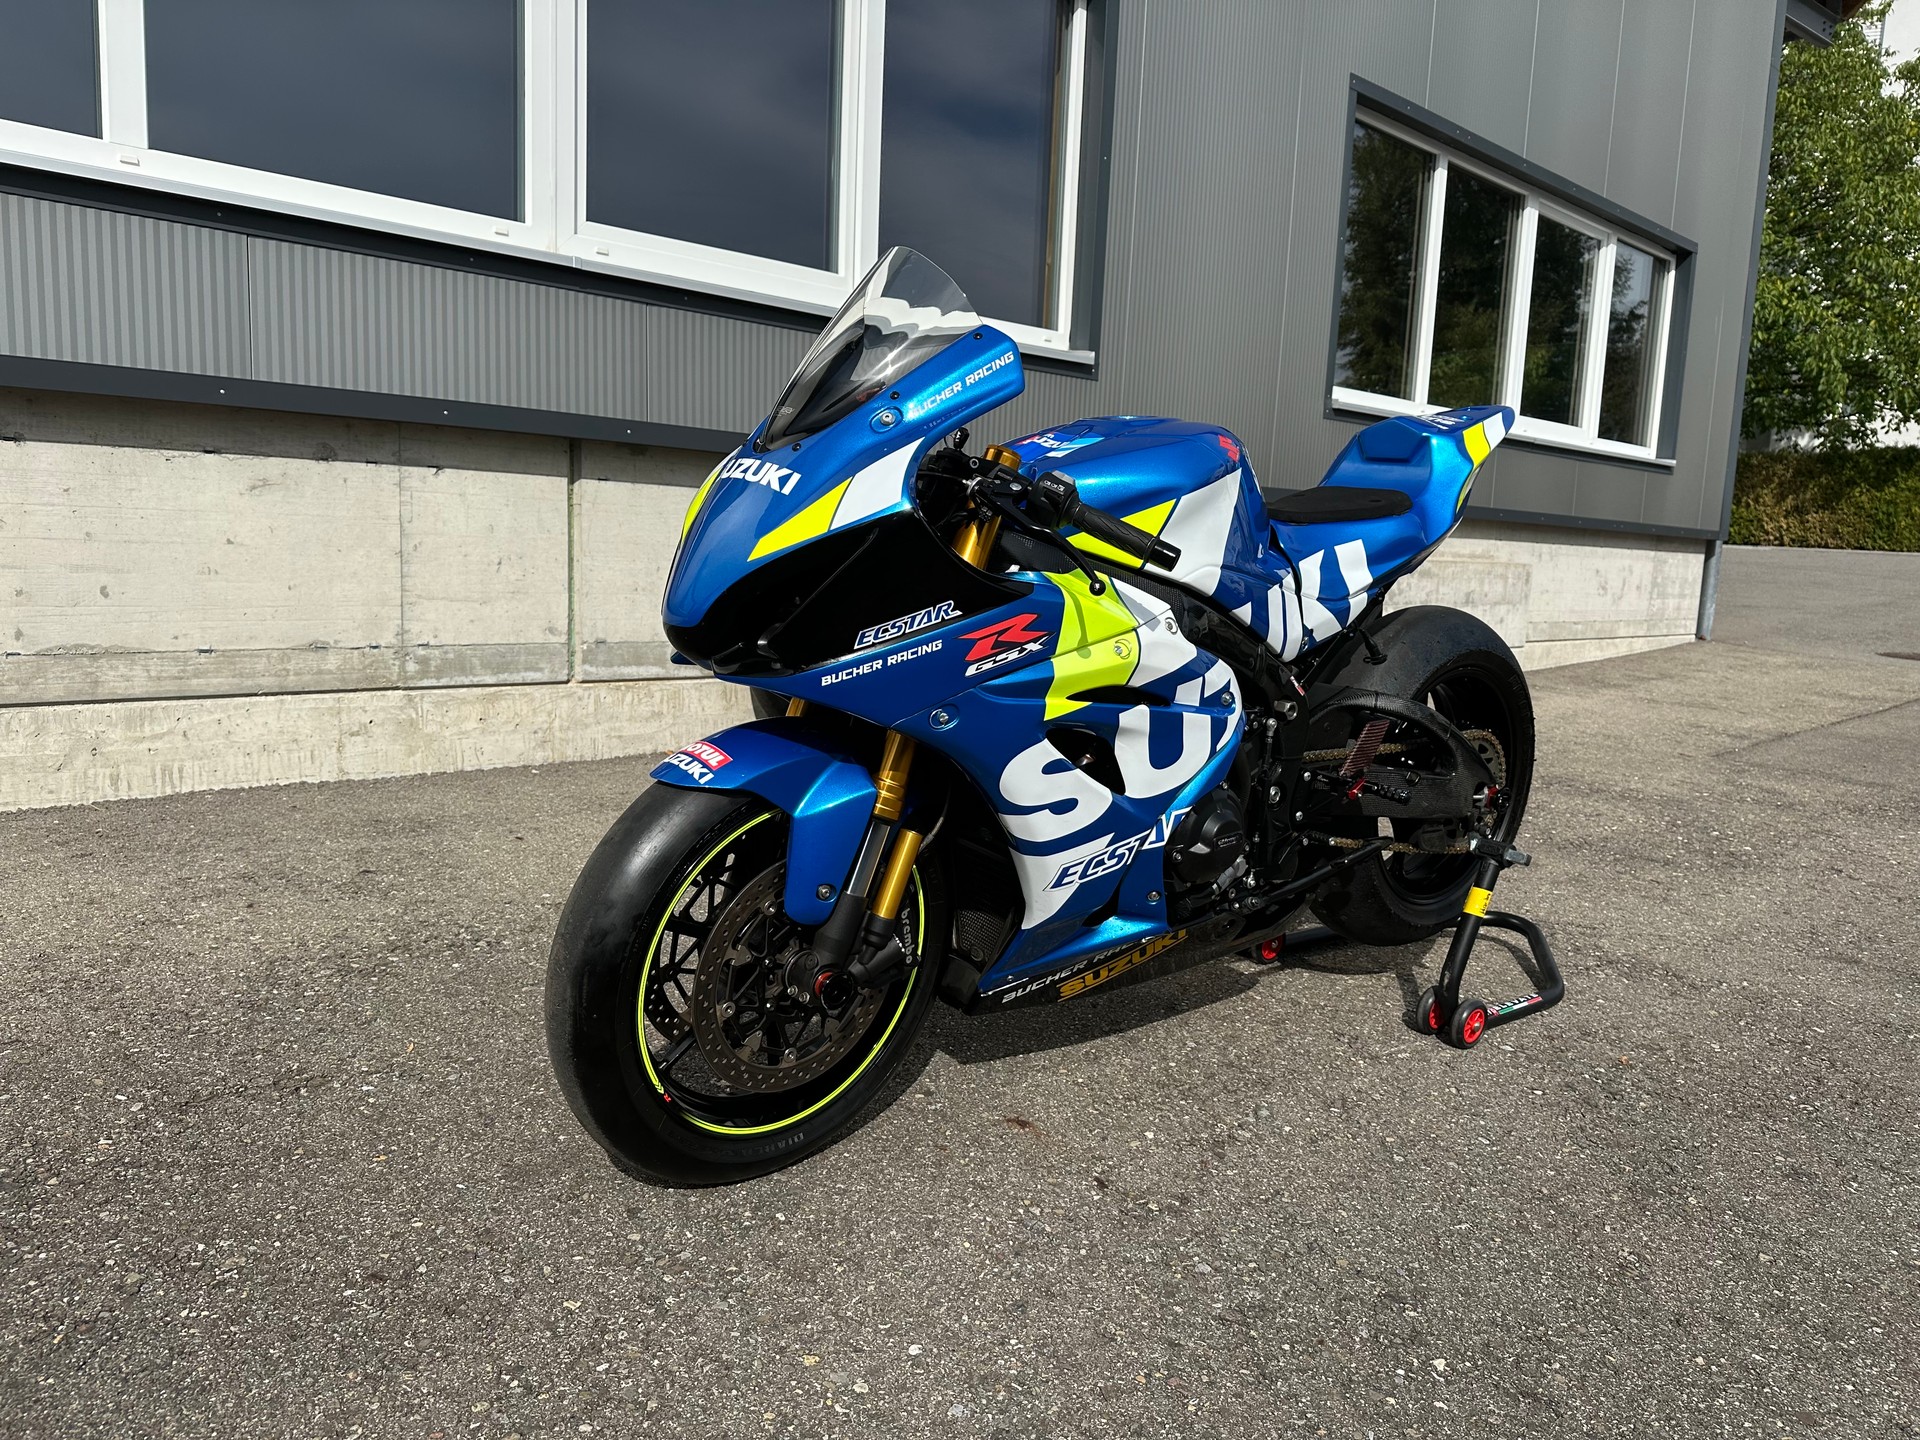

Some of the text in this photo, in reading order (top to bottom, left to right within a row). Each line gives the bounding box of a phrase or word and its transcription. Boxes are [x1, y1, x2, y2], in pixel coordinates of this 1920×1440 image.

[965, 351, 1015, 386] RACING
[720, 458, 802, 496] UZUKI
[854, 600, 963, 650] ECSTAR
[821, 639, 943, 687] BUCHER RACING
[964, 633, 1054, 677] GSX
[685, 742, 725, 767] OTUL
[901, 907, 915, 964] brembo
[1002, 960, 1089, 1003] BUCHER
[1060, 928, 1187, 997] SUZUKI
